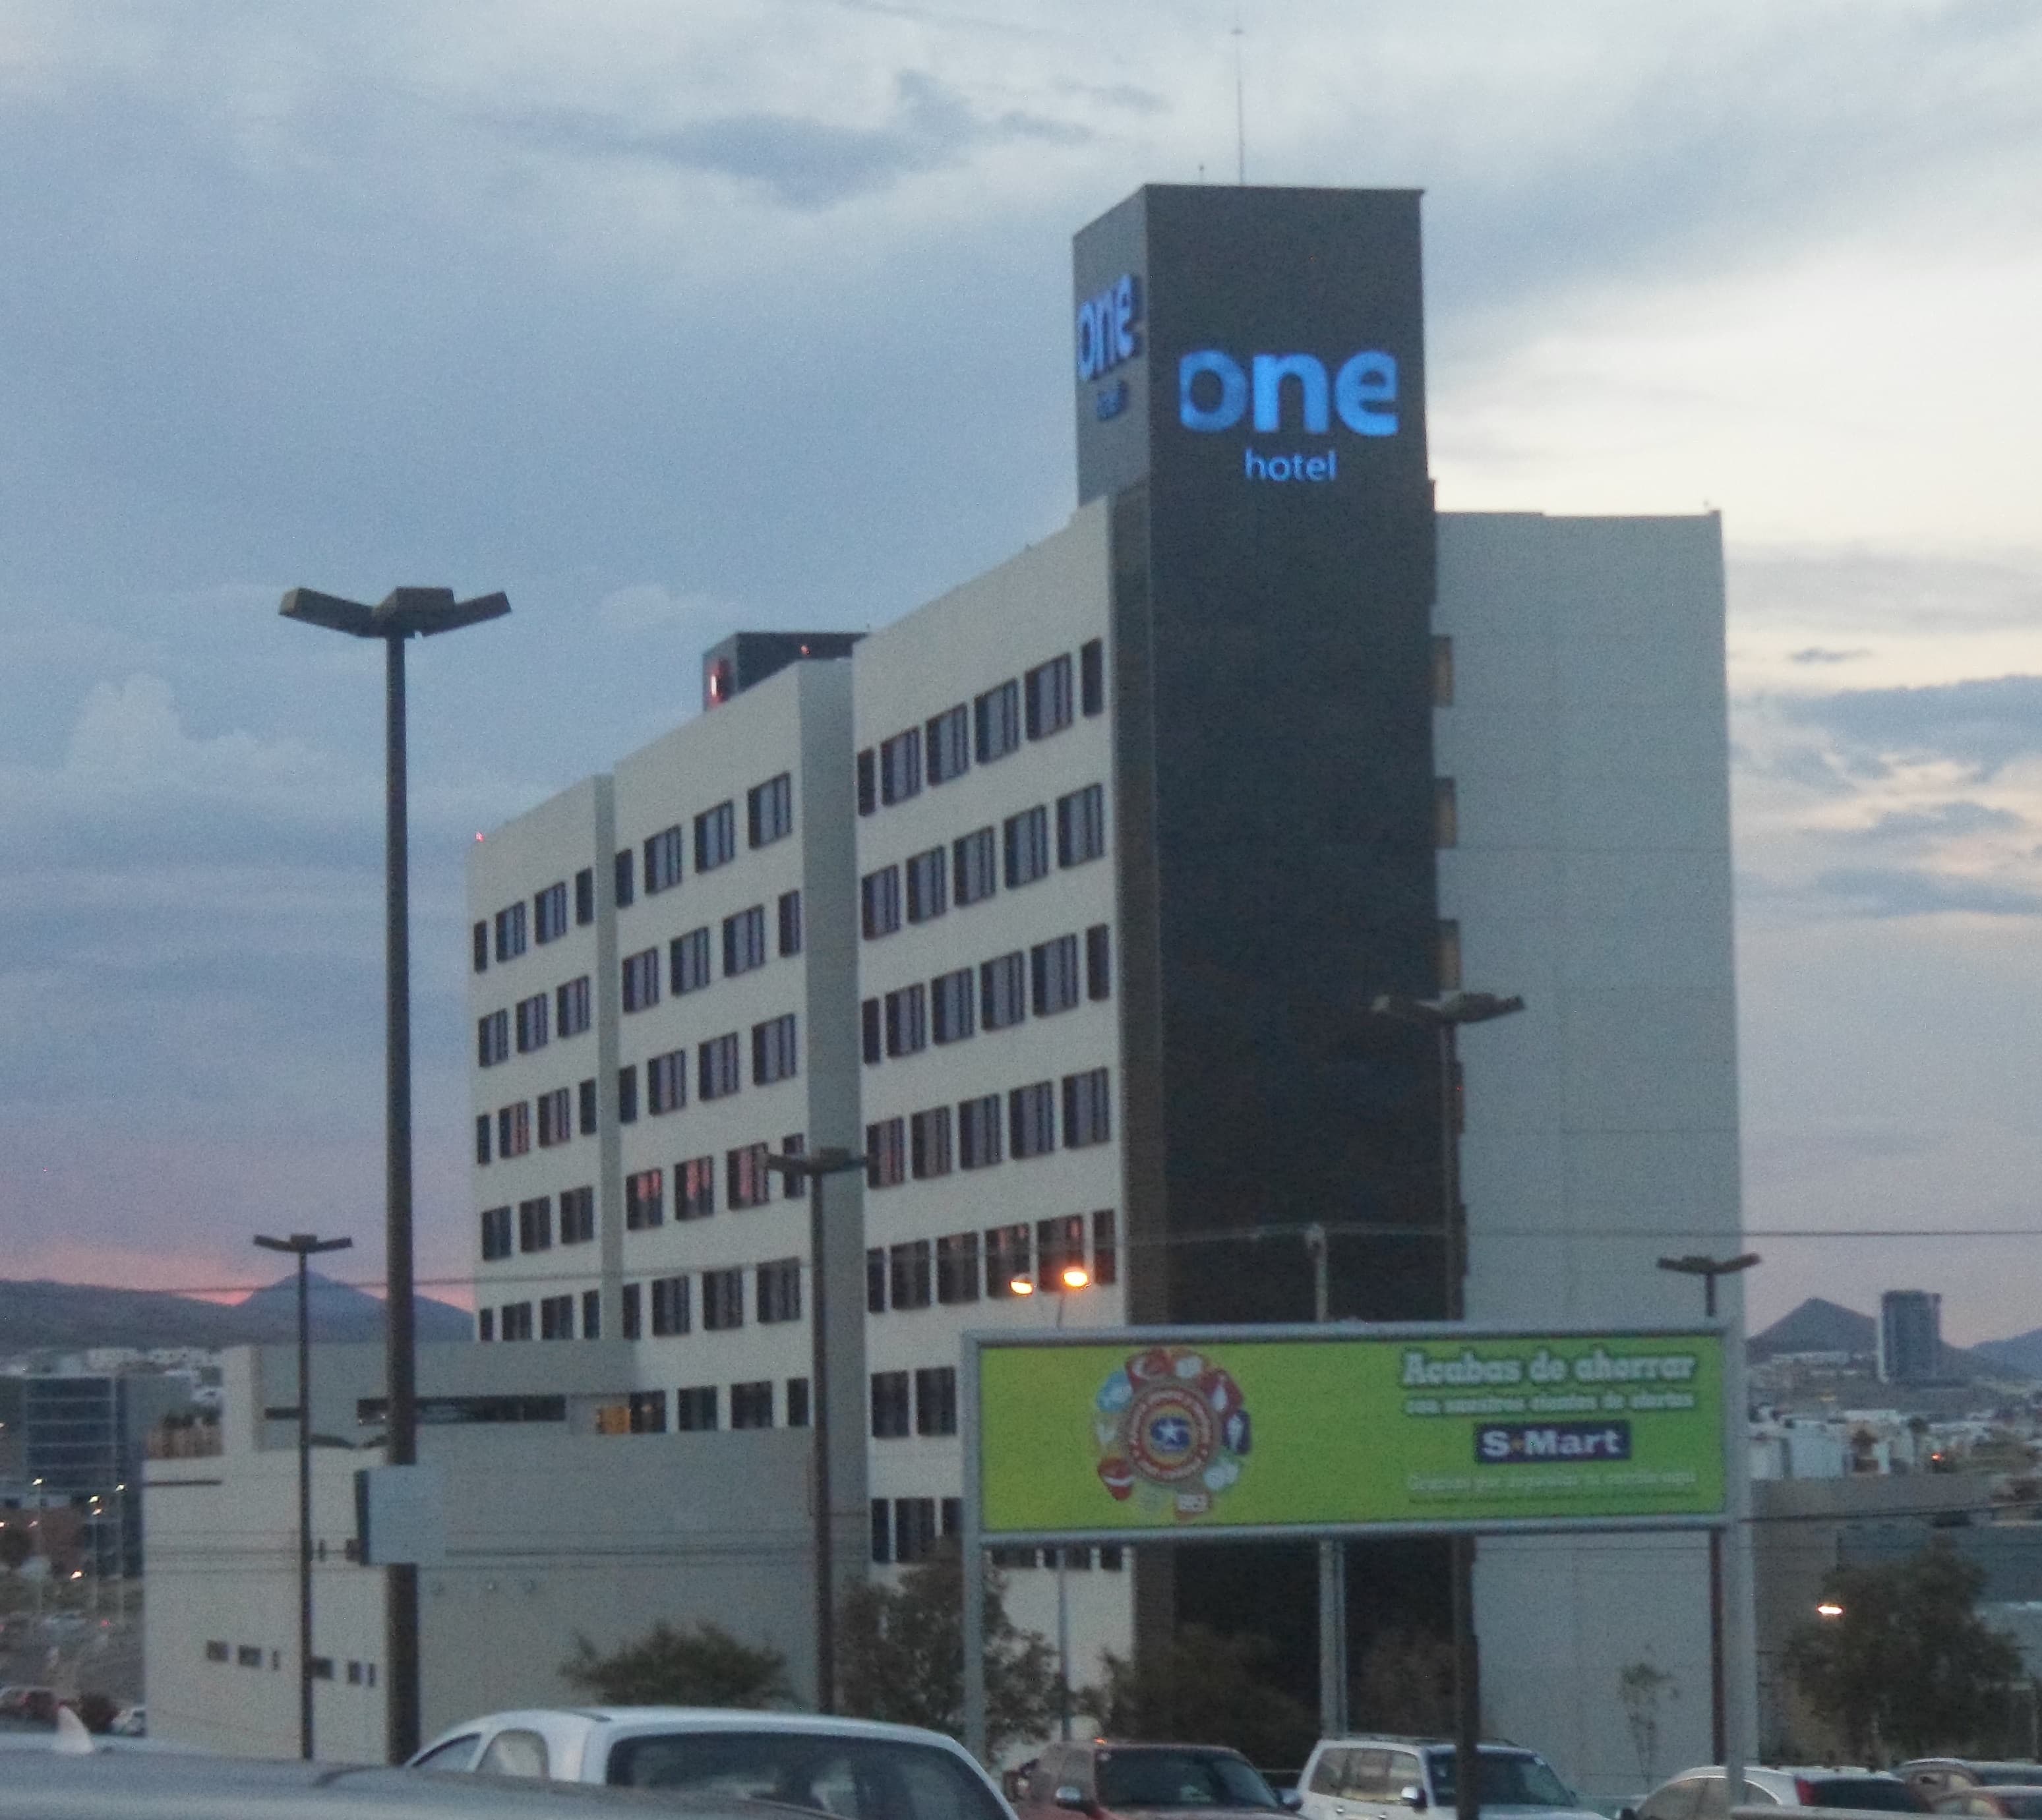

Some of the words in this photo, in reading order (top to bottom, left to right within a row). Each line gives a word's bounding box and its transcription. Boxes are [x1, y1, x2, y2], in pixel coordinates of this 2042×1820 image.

[1077, 273, 1133, 381] one
[1180, 349, 1399, 436] one
[1245, 448, 1337, 482] hotel
[1402, 1349, 1522, 1385] Acabas
[1528, 1348, 1567, 1382] de
[1574, 1347, 1696, 1382] ahorrar
